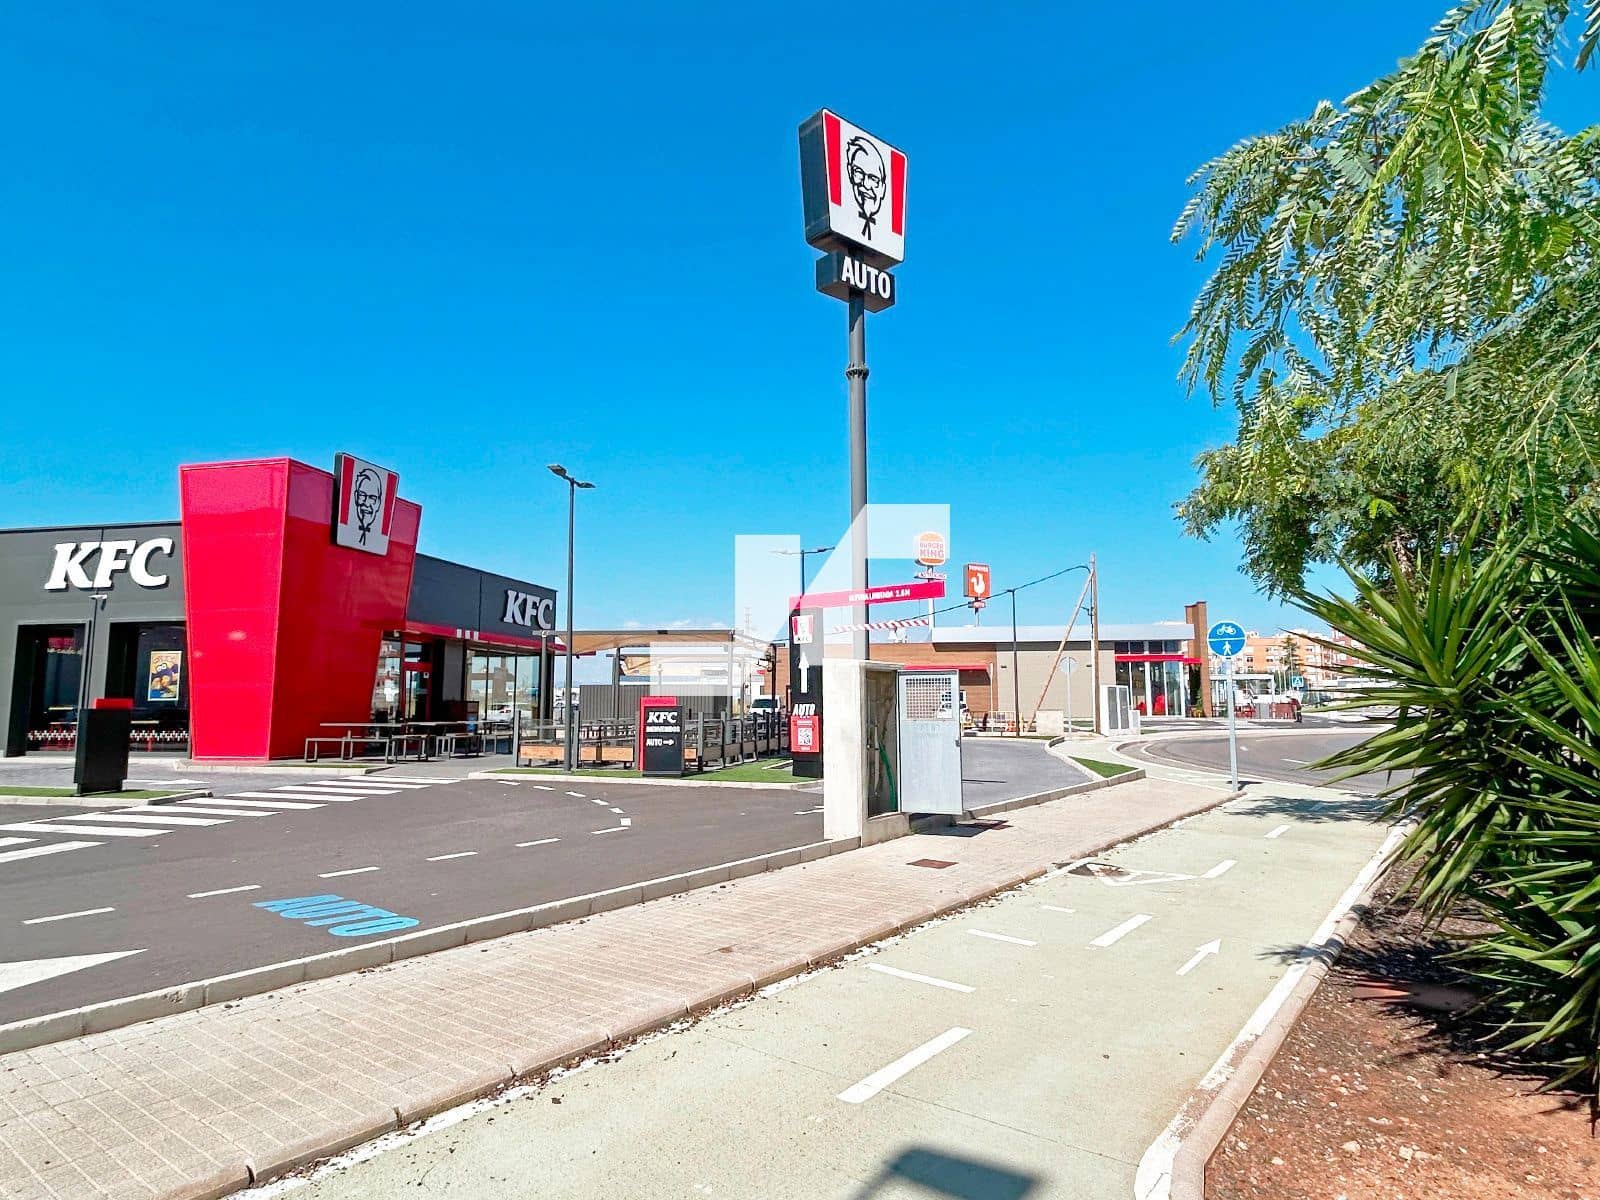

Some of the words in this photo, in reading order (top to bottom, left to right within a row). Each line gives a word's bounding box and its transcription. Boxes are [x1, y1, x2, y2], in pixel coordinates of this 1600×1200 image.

[841, 255, 891, 299] AUTO
[44, 537, 173, 590] KFC
[919, 549, 945, 558] KING
[503, 589, 553, 629] KFC
[646, 711, 678, 724] KFC
[792, 703, 816, 718] AUTO
[645, 738, 663, 746] AUTO
[252, 894, 420, 937] AUTO
